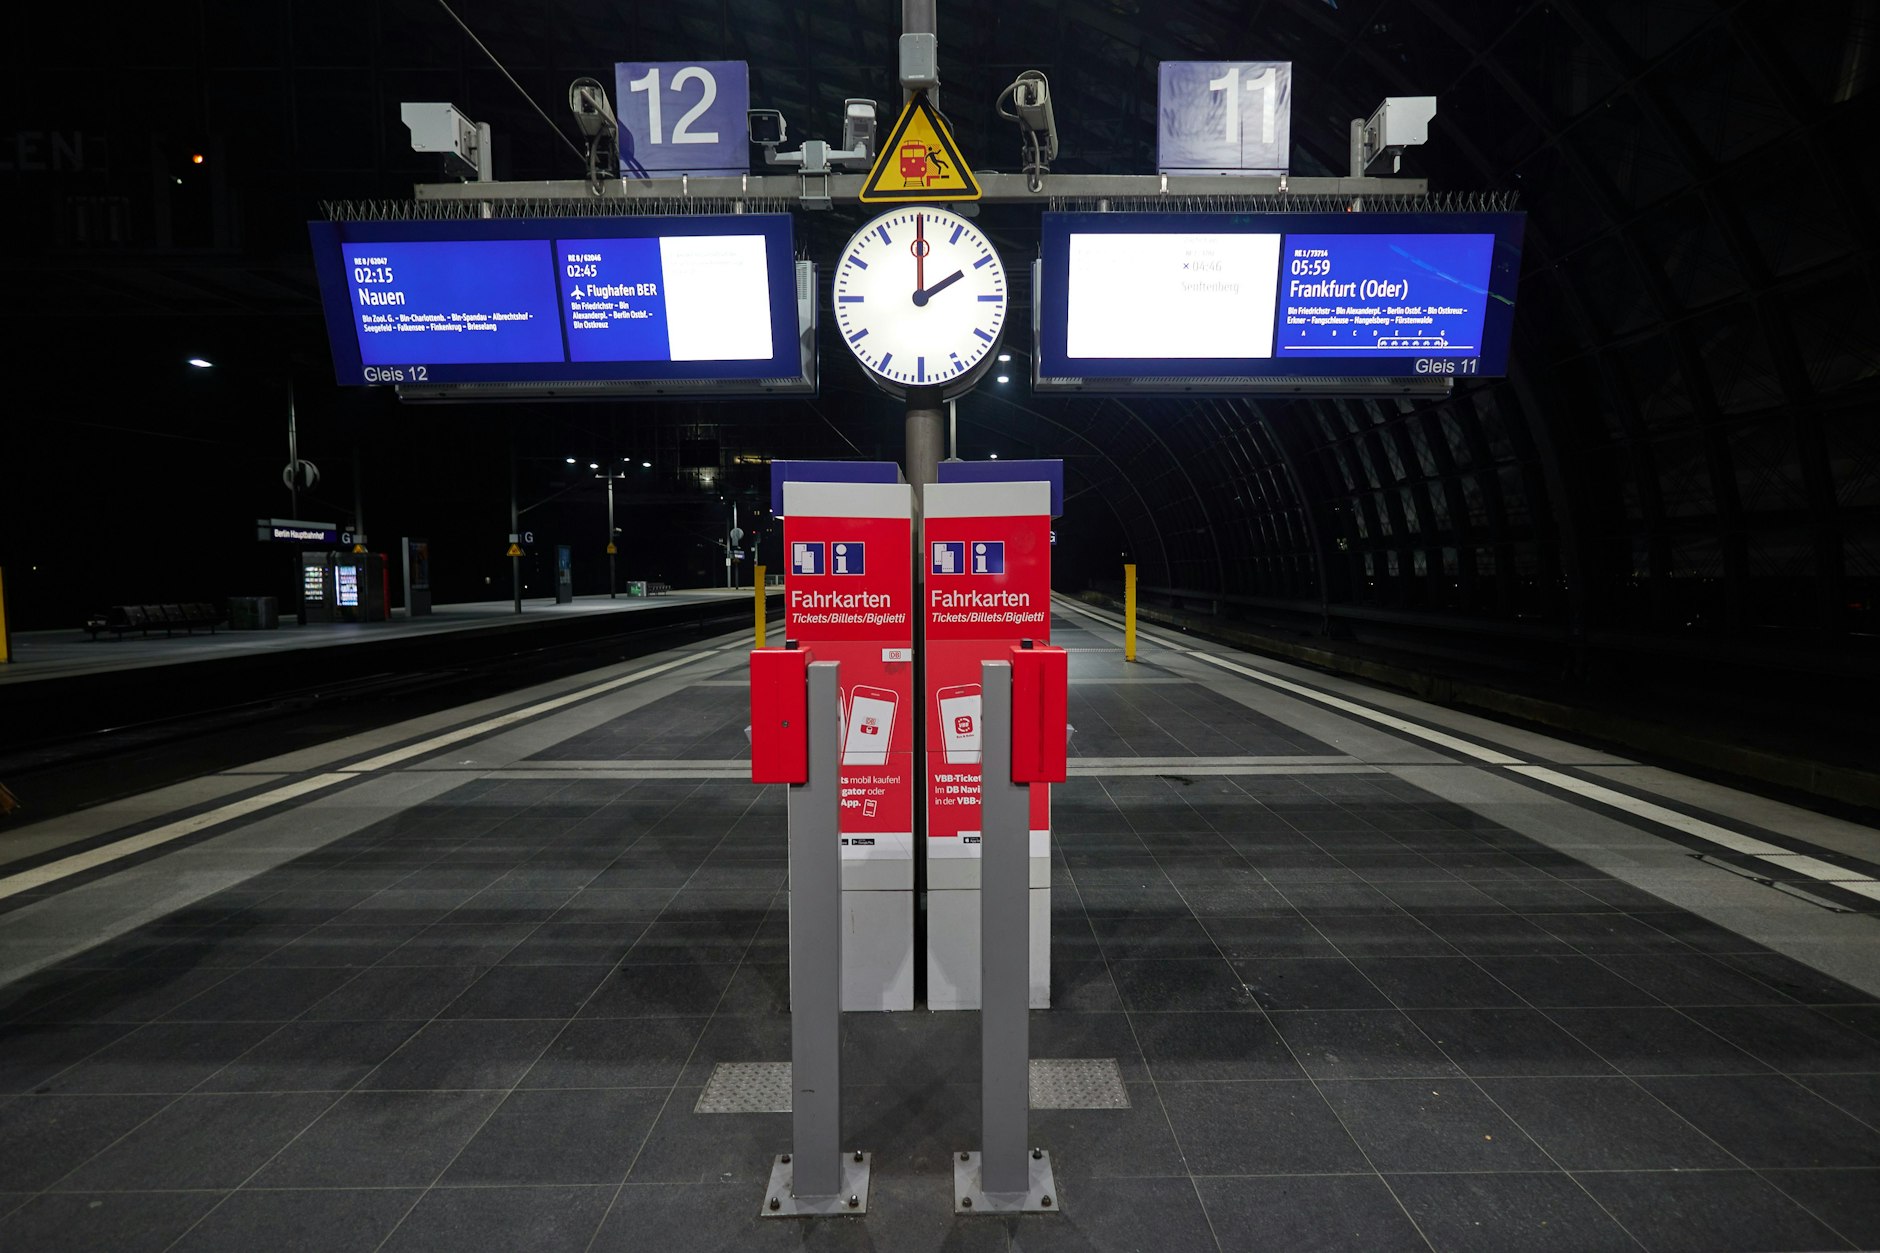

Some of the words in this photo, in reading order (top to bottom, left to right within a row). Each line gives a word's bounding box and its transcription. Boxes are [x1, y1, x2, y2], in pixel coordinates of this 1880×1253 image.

[630, 66, 719, 145] 12
[1209, 67, 1276, 144] 11
[567, 264, 597, 278] 02:45
[1291, 260, 1331, 275] 05:59
[355, 267, 394, 283] 02:15
[586, 283, 635, 300] Flughafen
[636, 283, 657, 296] BER
[1290, 279, 1356, 297] Frankfurt
[1360, 279, 1408, 300] (Oder)
[358, 288, 405, 305] Nauen
[492, 312, 528, 321] Albrechtshof
[613, 310, 630, 319] Berlin
[1387, 306, 1404, 315] Berlin
[1437, 306, 1463, 315] Ostkreuz
[583, 320, 608, 329] Ostkreuz
[1287, 316, 1306, 324] Erkner
[1311, 316, 1349, 325] Fangschleuse
[1354, 316, 1390, 325] Hangelsberg
[1394, 316, 1433, 324] Fürstenwalde
[363, 323, 392, 333] Seegefeld
[397, 323, 425, 331] Falkensee
[430, 323, 463, 332] Finkenkrug
[467, 322, 497, 331] Brieselang
[1415, 358, 1455, 374] Gleis
[1461, 358, 1477, 373] 11
[364, 366, 404, 382] Gleis
[408, 366, 428, 381] 12
[274, 528, 291, 538] Berlin
[290, 529, 324, 540] Hauptbahnhof
[341, 532, 351, 544] G
[524, 531, 534, 543] G
[791, 590, 891, 608] Fahrkarten
[931, 589, 1030, 607] Fahrkarten
[792, 612, 906, 625] Tickets/Billets/Biglietti
[932, 611, 1044, 625] Tickets/Billets/Biglietti
[890, 651, 900, 659] DB
[850, 775, 871, 784] mobil
[872, 775, 901, 784] kaufen!
[867, 787, 885, 795] oder
[935, 785, 945, 794] Im
[946, 785, 960, 794] DB
[935, 797, 942, 805] in
[943, 797, 956, 805] der
